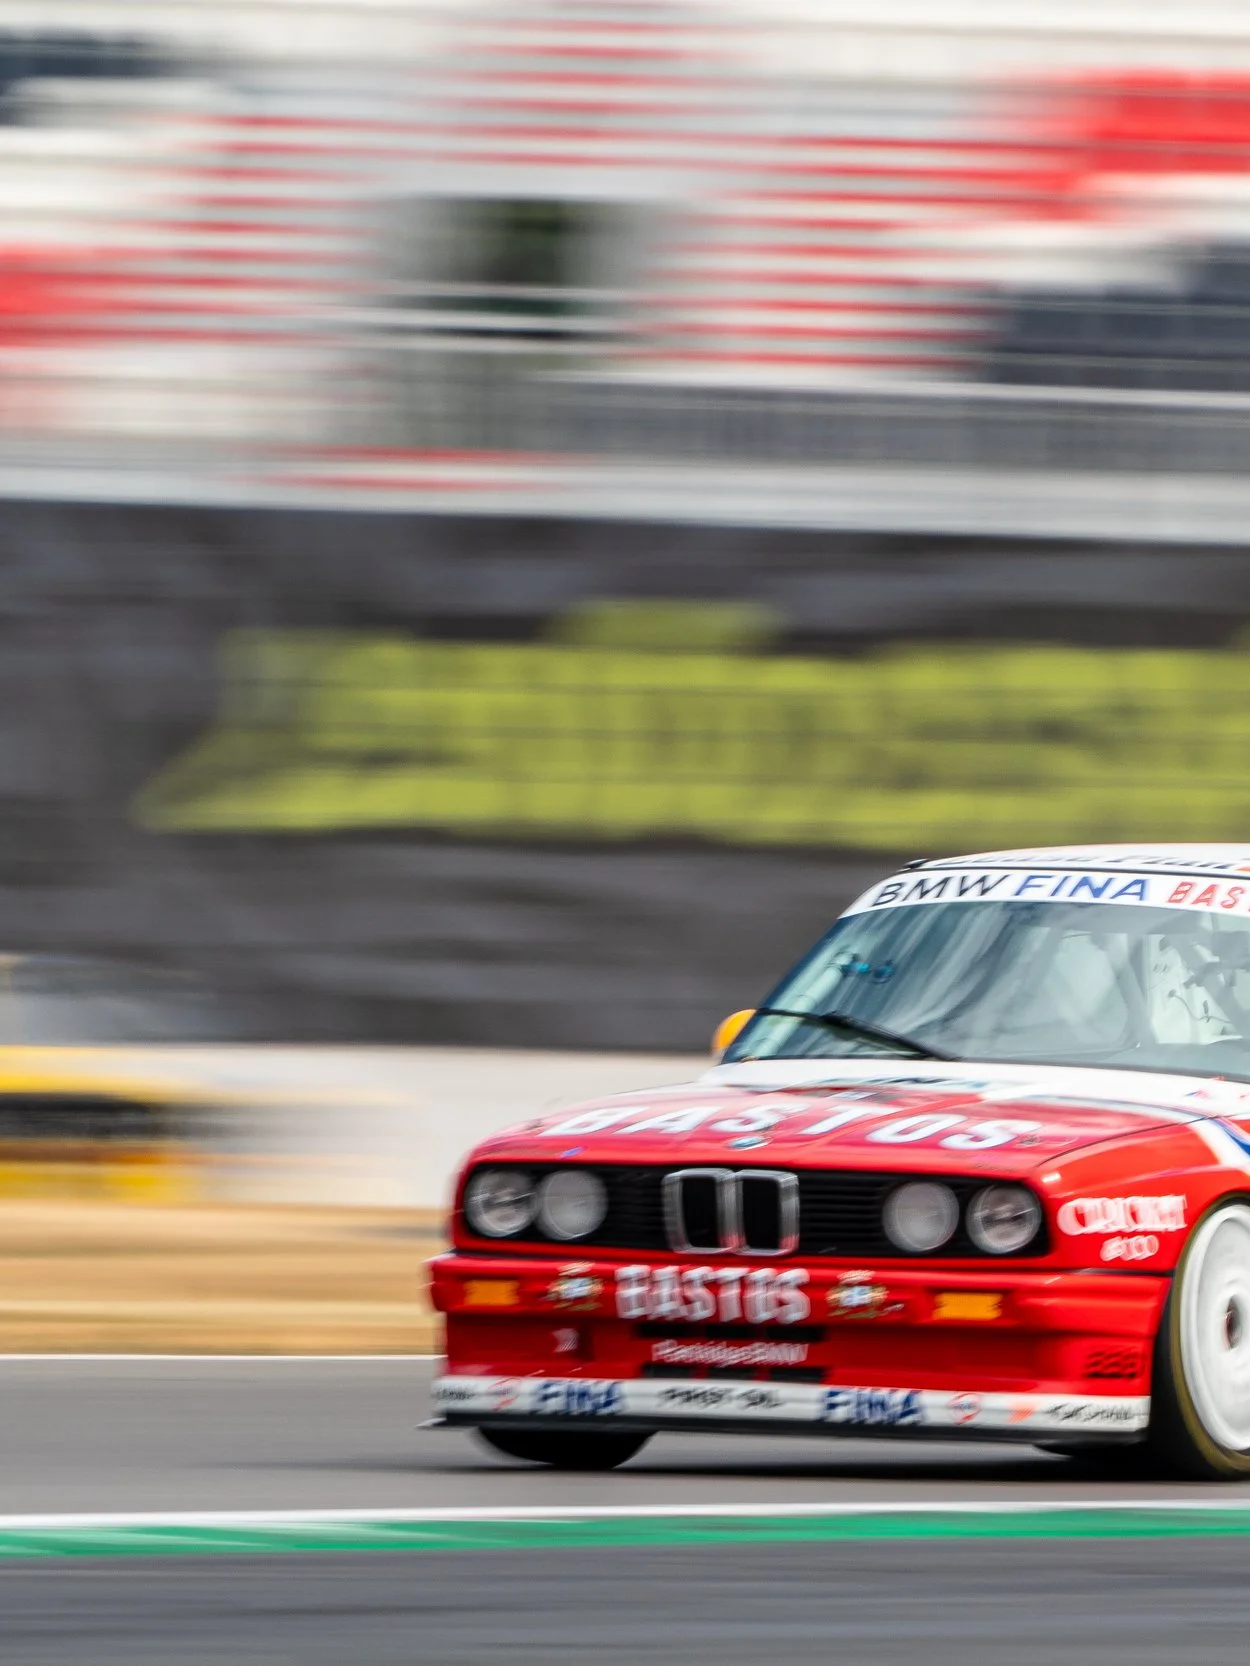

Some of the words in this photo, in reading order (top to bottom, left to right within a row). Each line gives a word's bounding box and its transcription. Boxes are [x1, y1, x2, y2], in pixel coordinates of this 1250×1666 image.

[869, 874, 1012, 908] BMW
[1013, 874, 1151, 901] FINA
[537, 1103, 1043, 1150] BASTOS
[614, 1263, 811, 1325] BASTOS
